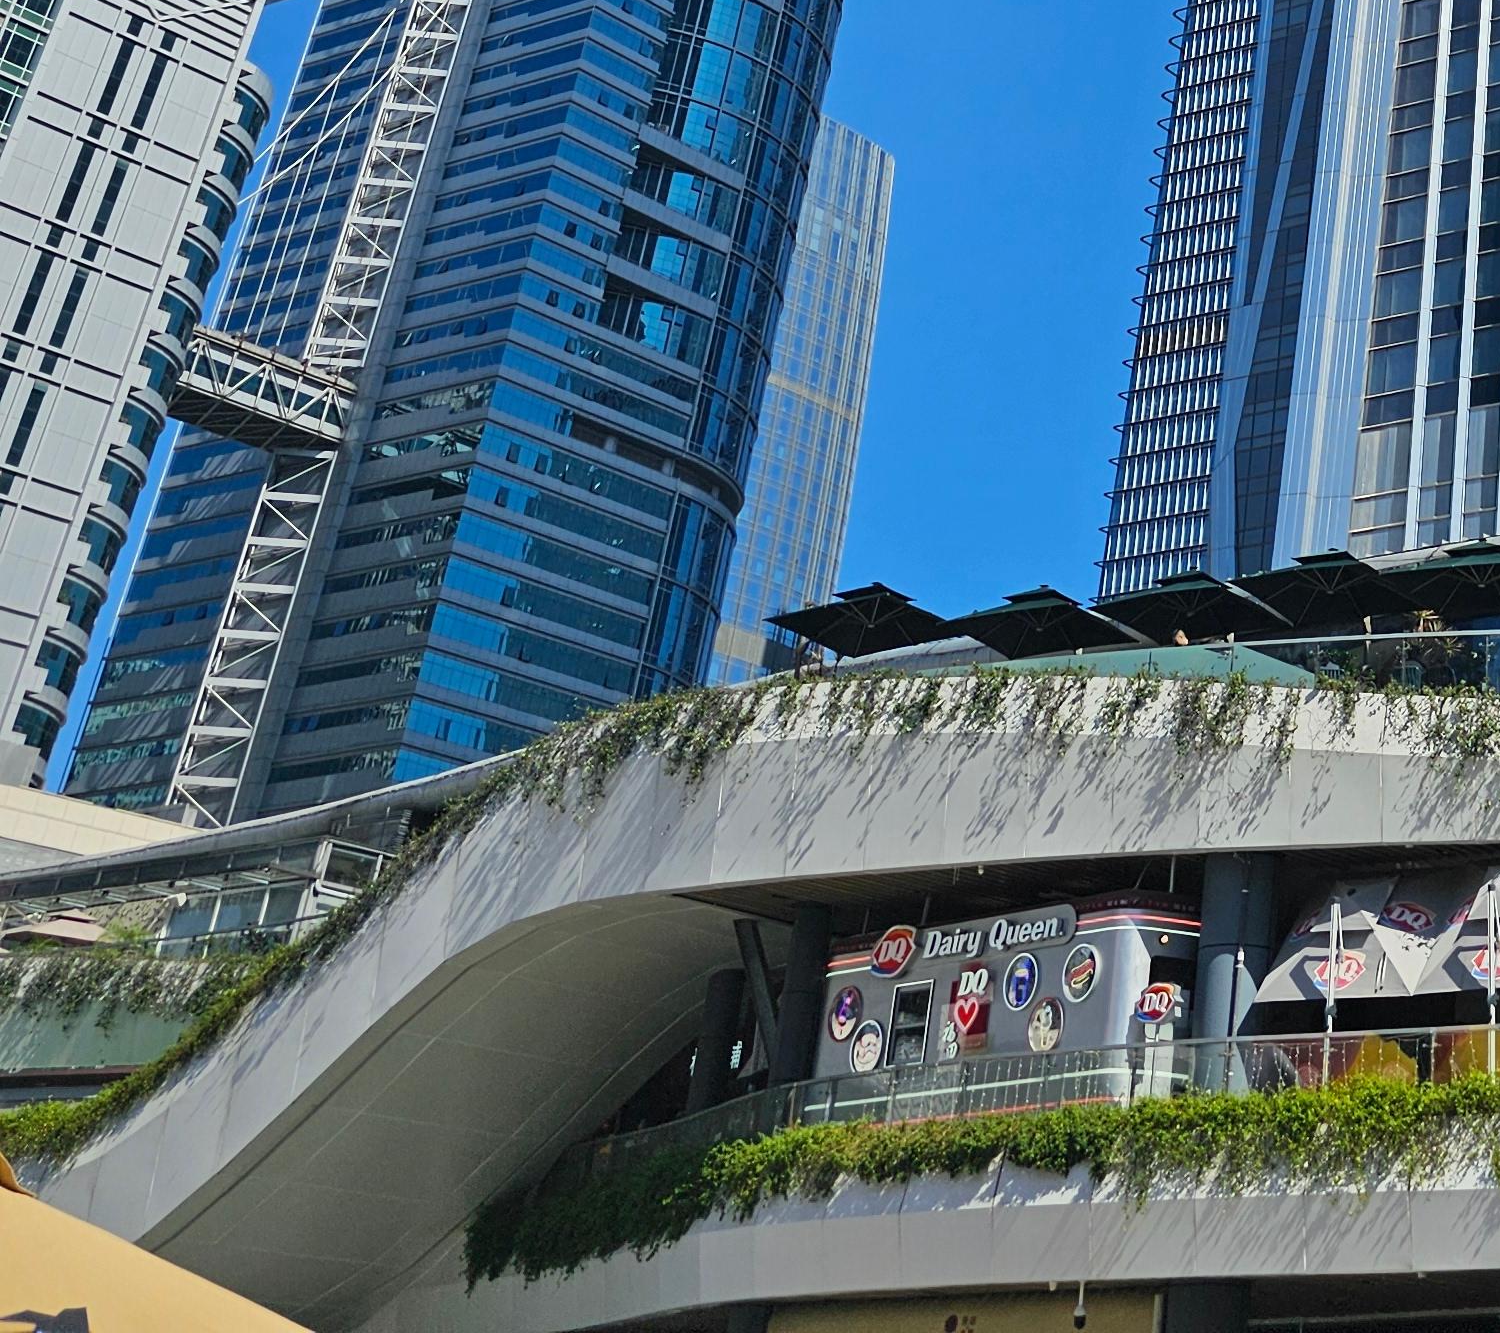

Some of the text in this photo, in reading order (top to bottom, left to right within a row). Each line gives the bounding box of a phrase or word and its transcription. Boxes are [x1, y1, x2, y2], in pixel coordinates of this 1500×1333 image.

[1390, 906, 1427, 928] DQ
[879, 936, 906, 963] DQ
[922, 929, 982, 959] Dairy
[958, 968, 989, 997] DQ
[1142, 991, 1169, 1013] DQ
